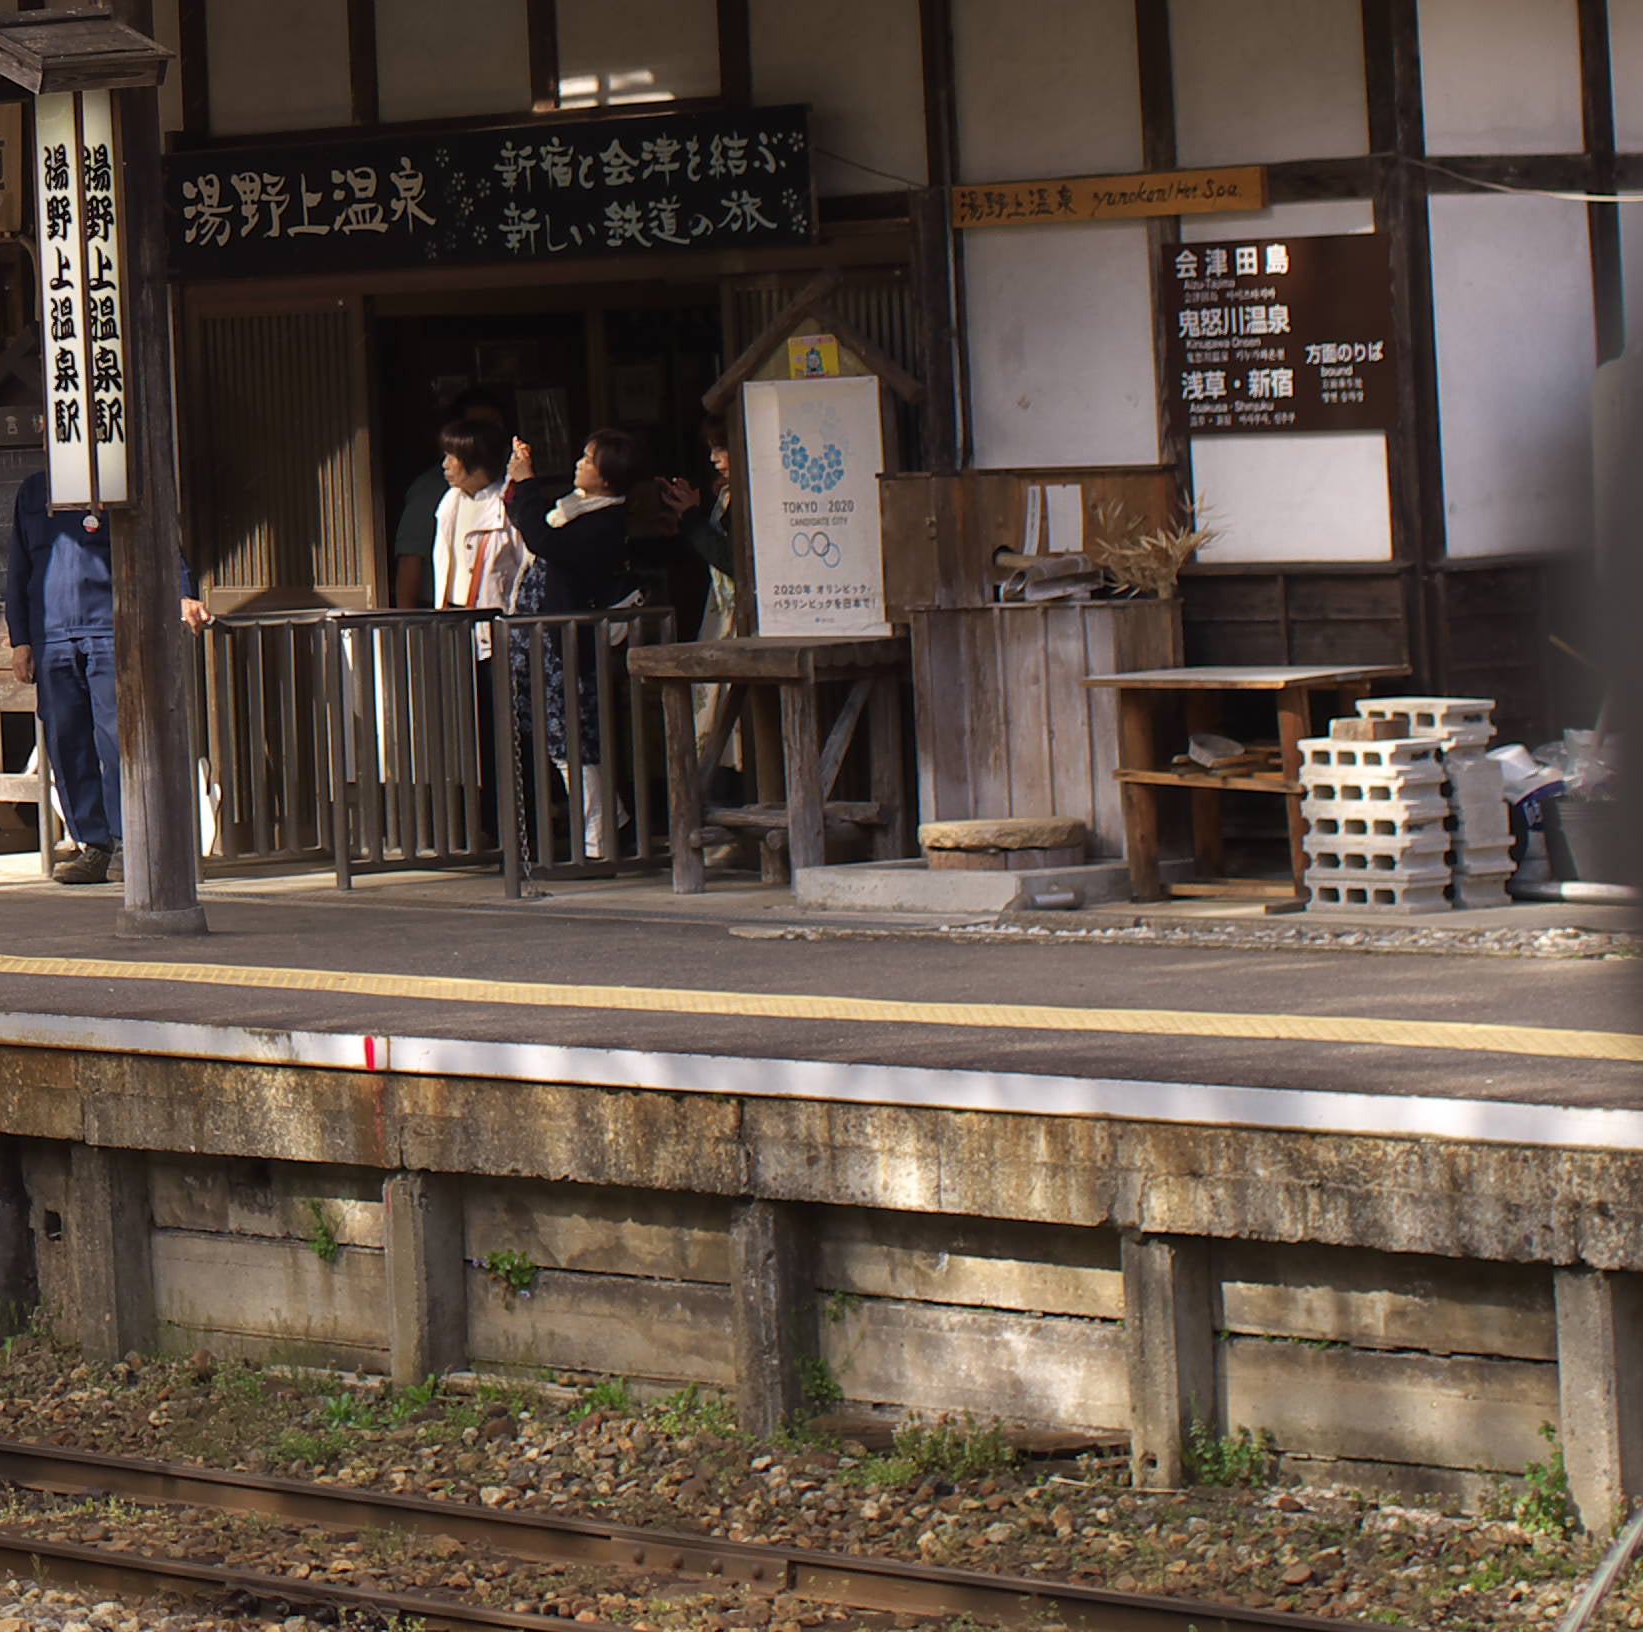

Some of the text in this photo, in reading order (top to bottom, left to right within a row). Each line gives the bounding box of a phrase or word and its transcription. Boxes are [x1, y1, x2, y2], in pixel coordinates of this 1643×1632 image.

[494, 131, 786, 192] 新宿と会津を結ぶ
[182, 156, 437, 248] 湯野上温泉
[497, 188, 779, 255] 新しい鉄道の旅
[1175, 243, 1290, 279] 会津田島
[44, 143, 82, 444] 湯野上温泉駅
[84, 142, 125, 445] 湯野上温泉駅
[1179, 304, 1290, 338] 鬼怒川温泉
[1305, 341, 1383, 364] 方面のりば
[1182, 368, 1294, 400] 浅草・新宿
[782, 500, 854, 513] TOKYO 2020
[790, 517, 848, 527] CANDIDATE CITY
[773, 585, 811, 596] 2020年
